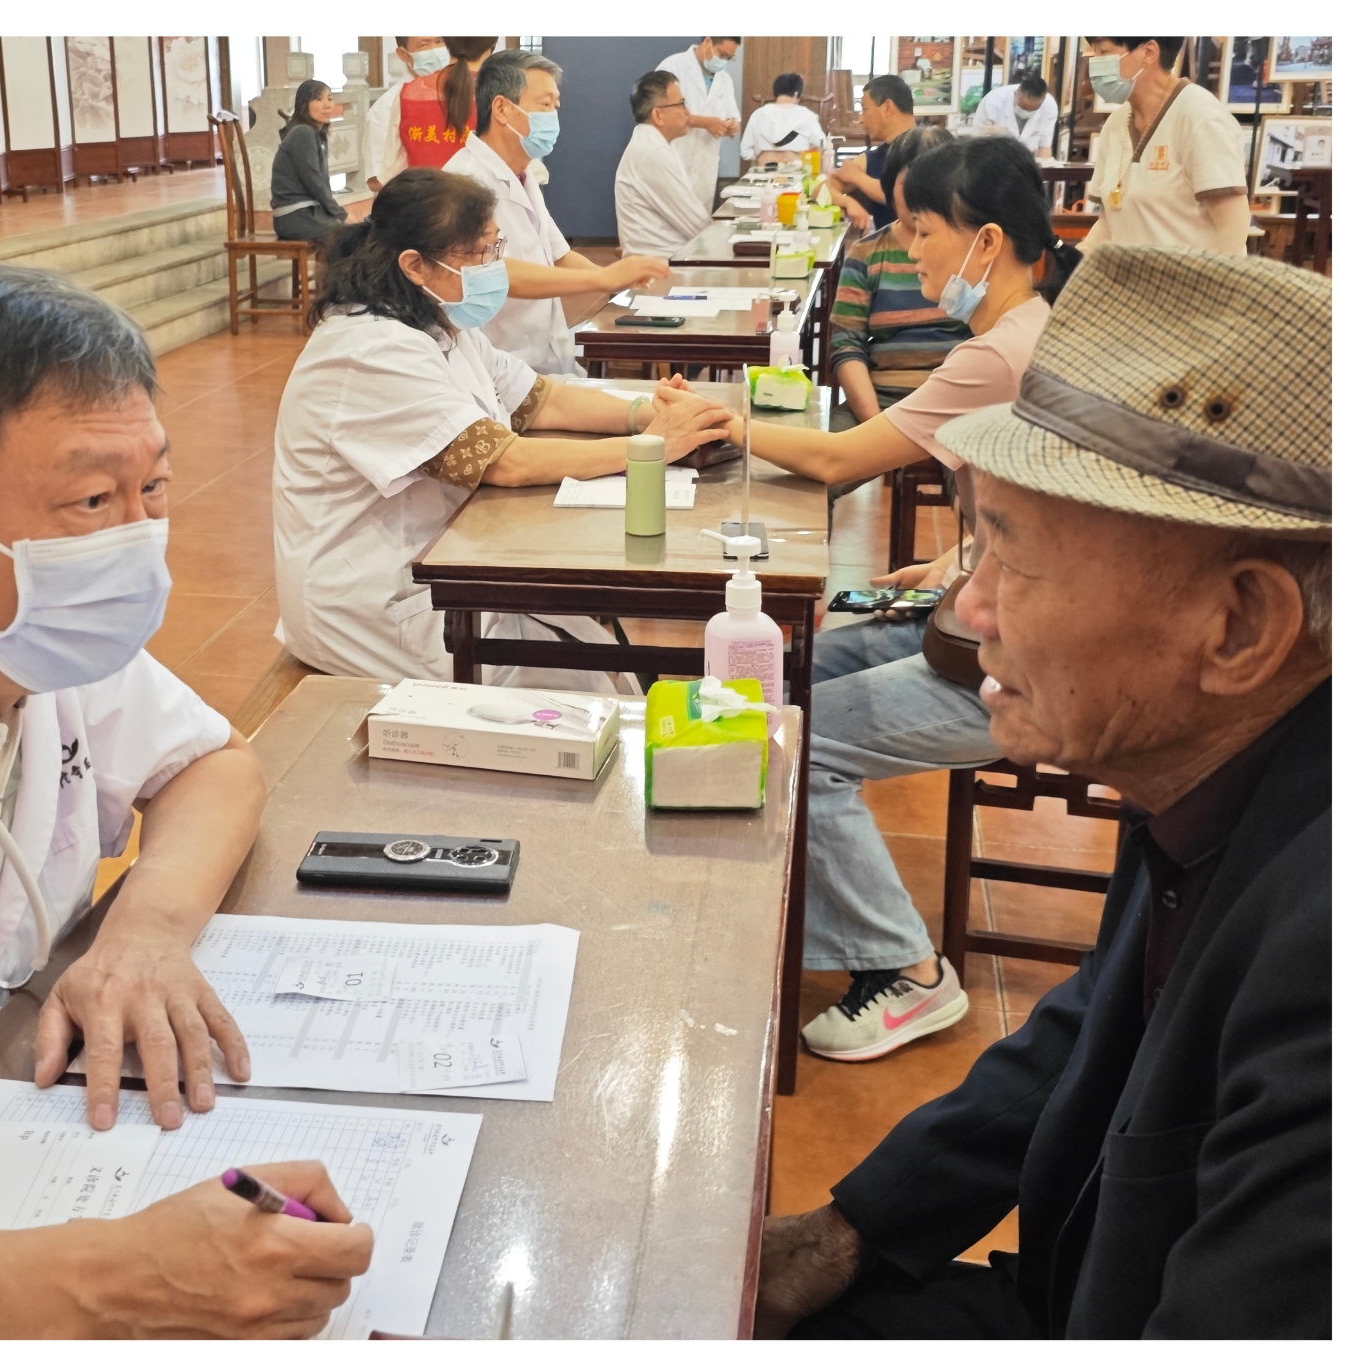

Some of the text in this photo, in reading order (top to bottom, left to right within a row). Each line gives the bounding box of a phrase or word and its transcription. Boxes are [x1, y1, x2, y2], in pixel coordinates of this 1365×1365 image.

[382, 729, 409, 739] 听诊器
[382, 739, 420, 749] Stethoscope
[345, 971, 364, 986] 01
[433, 1053, 452, 1068] 02
[68, 1166, 103, 1221] 义诊院处方
[400, 1221, 424, 1264] 就诊记录表
